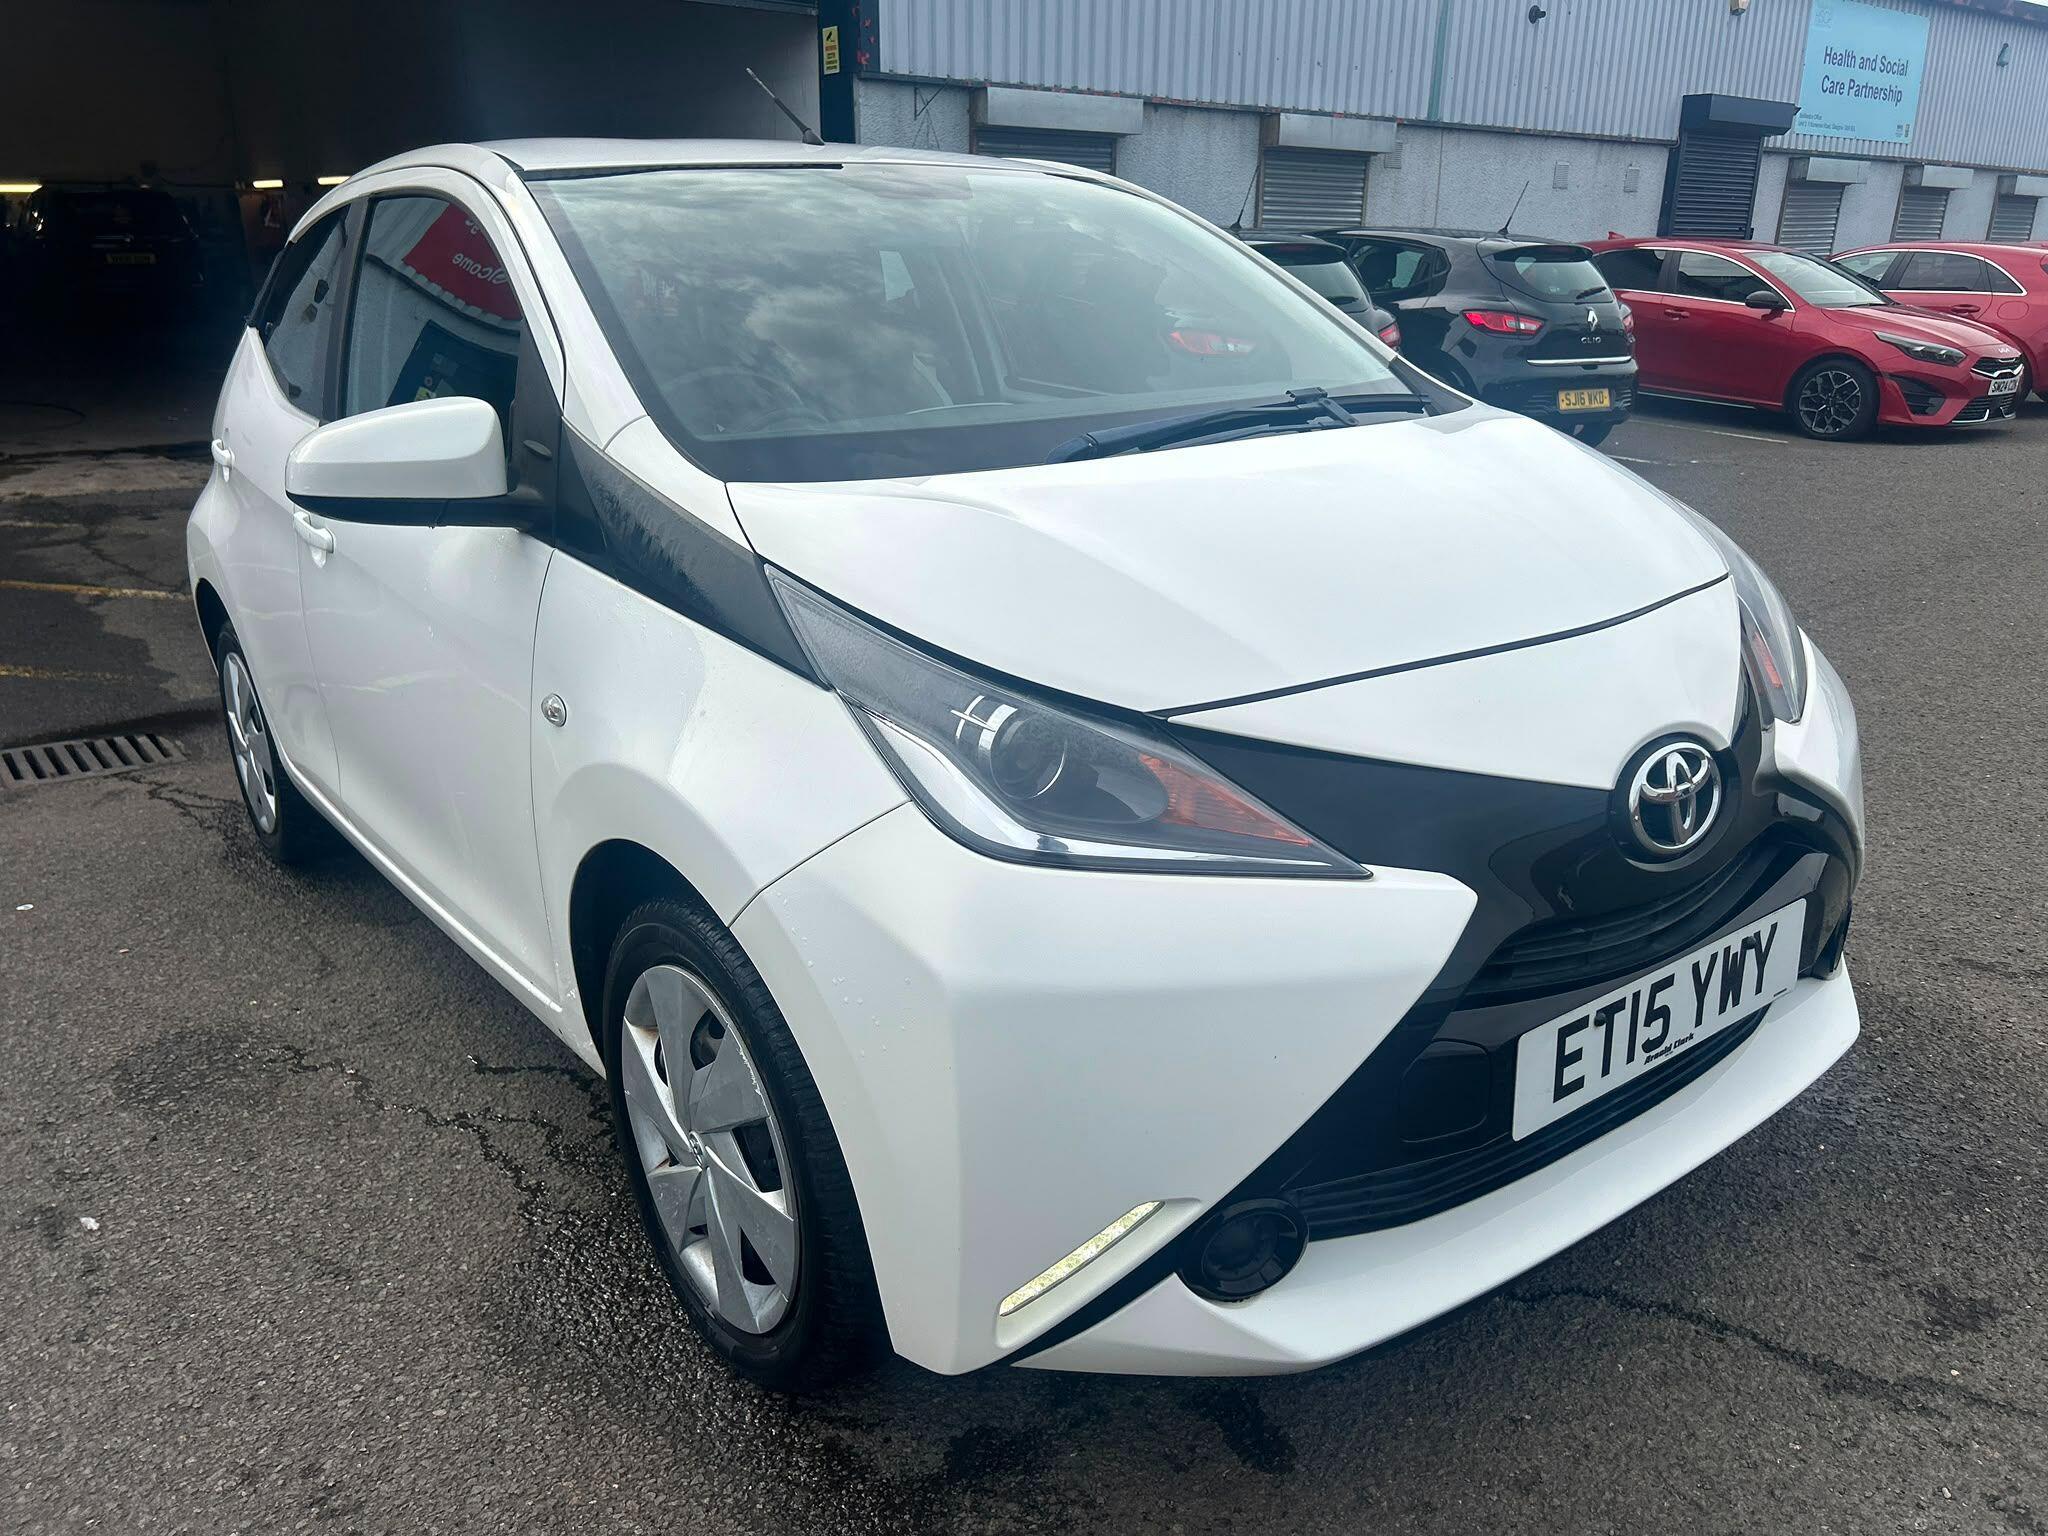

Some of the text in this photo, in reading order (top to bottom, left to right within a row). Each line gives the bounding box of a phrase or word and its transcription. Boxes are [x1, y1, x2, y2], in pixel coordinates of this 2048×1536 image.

[1823, 46, 1909, 77] Health and Social
[1821, 75, 1903, 107] Care Partnership
[1581, 336, 1602, 344] CLIO
[1565, 391, 1586, 407] SJ16
[1553, 921, 1778, 1104] ET15 YWY
